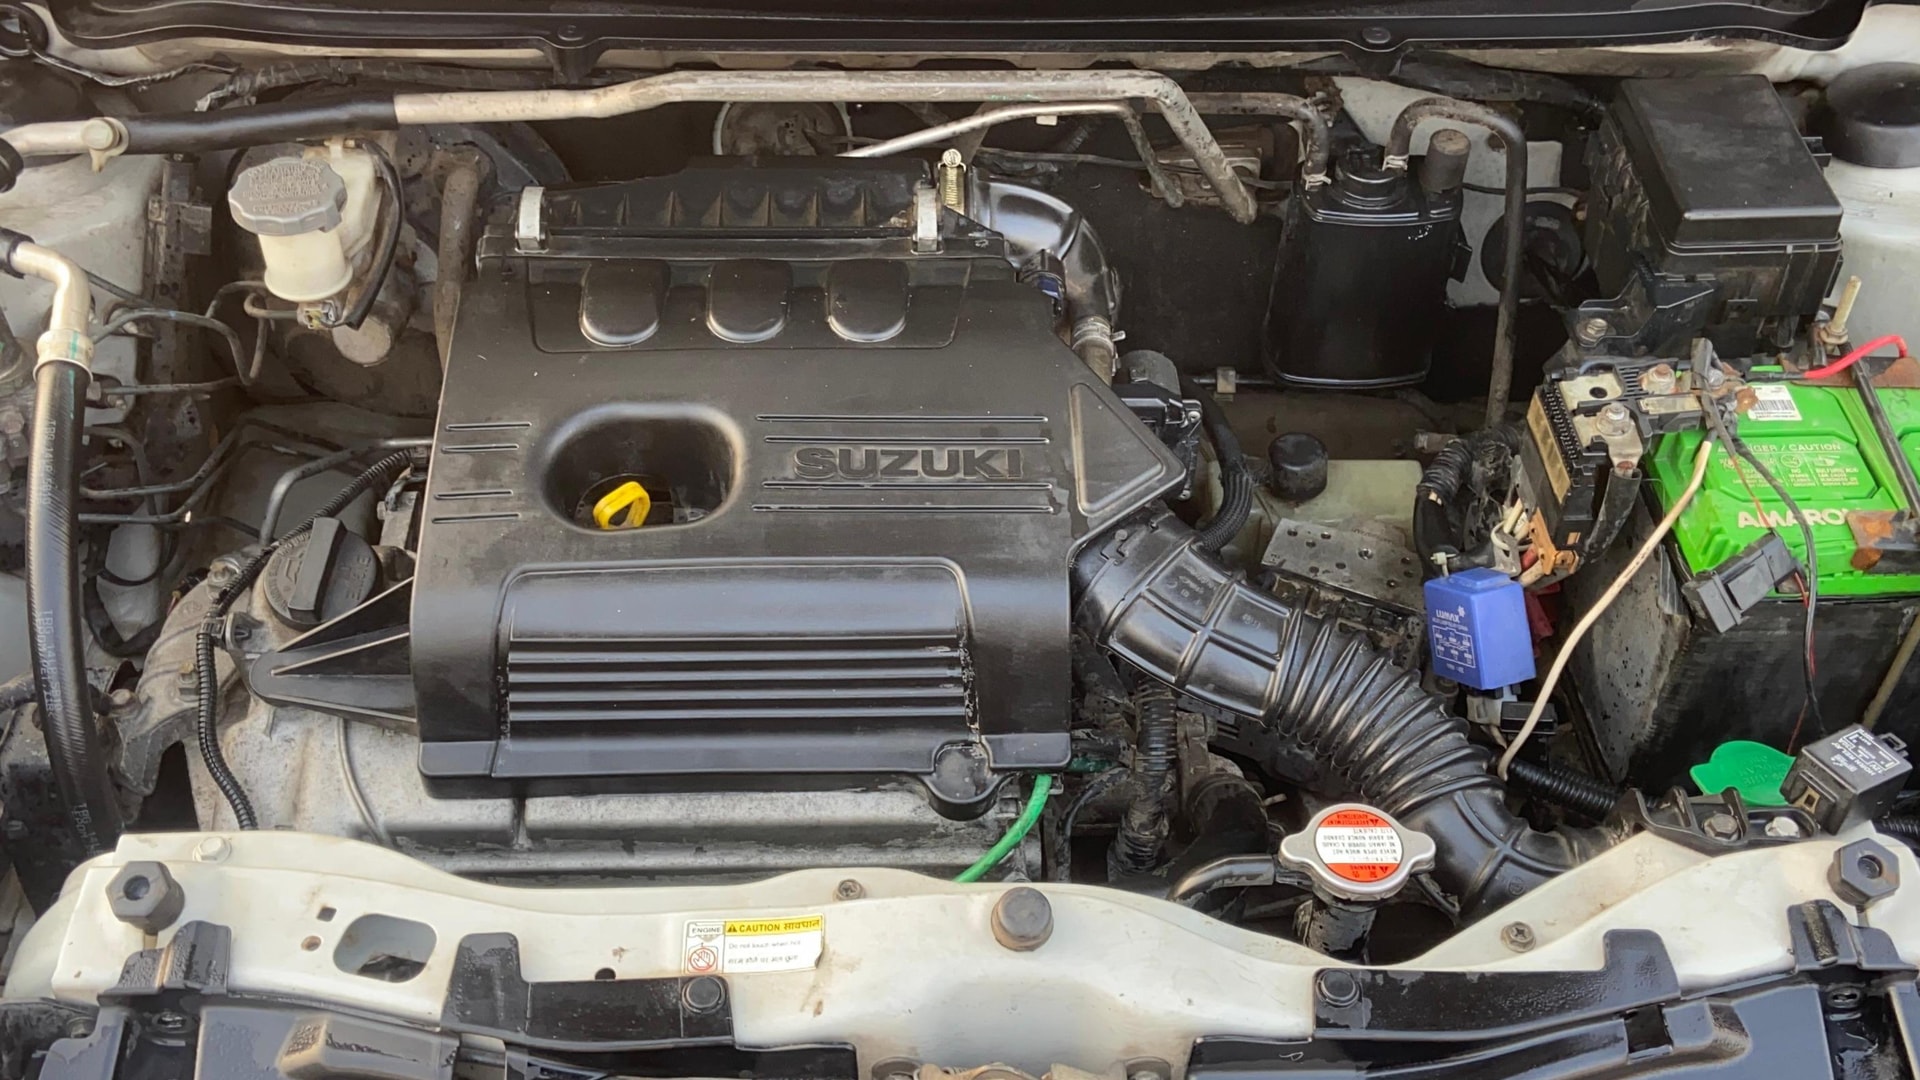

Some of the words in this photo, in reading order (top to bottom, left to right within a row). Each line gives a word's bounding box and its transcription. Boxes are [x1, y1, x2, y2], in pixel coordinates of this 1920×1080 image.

[1788, 443, 1841, 451] CAUTION
[794, 446, 1023, 480] SUZUKI
[1737, 507, 1850, 529] AMARO
[1435, 609, 1460, 624] LUMAX
[1831, 741, 1856, 763] RELAY
[1855, 758, 1877, 776] HORN
[739, 924, 781, 933] CAUTION
[783, 919, 820, 930] सावधान
